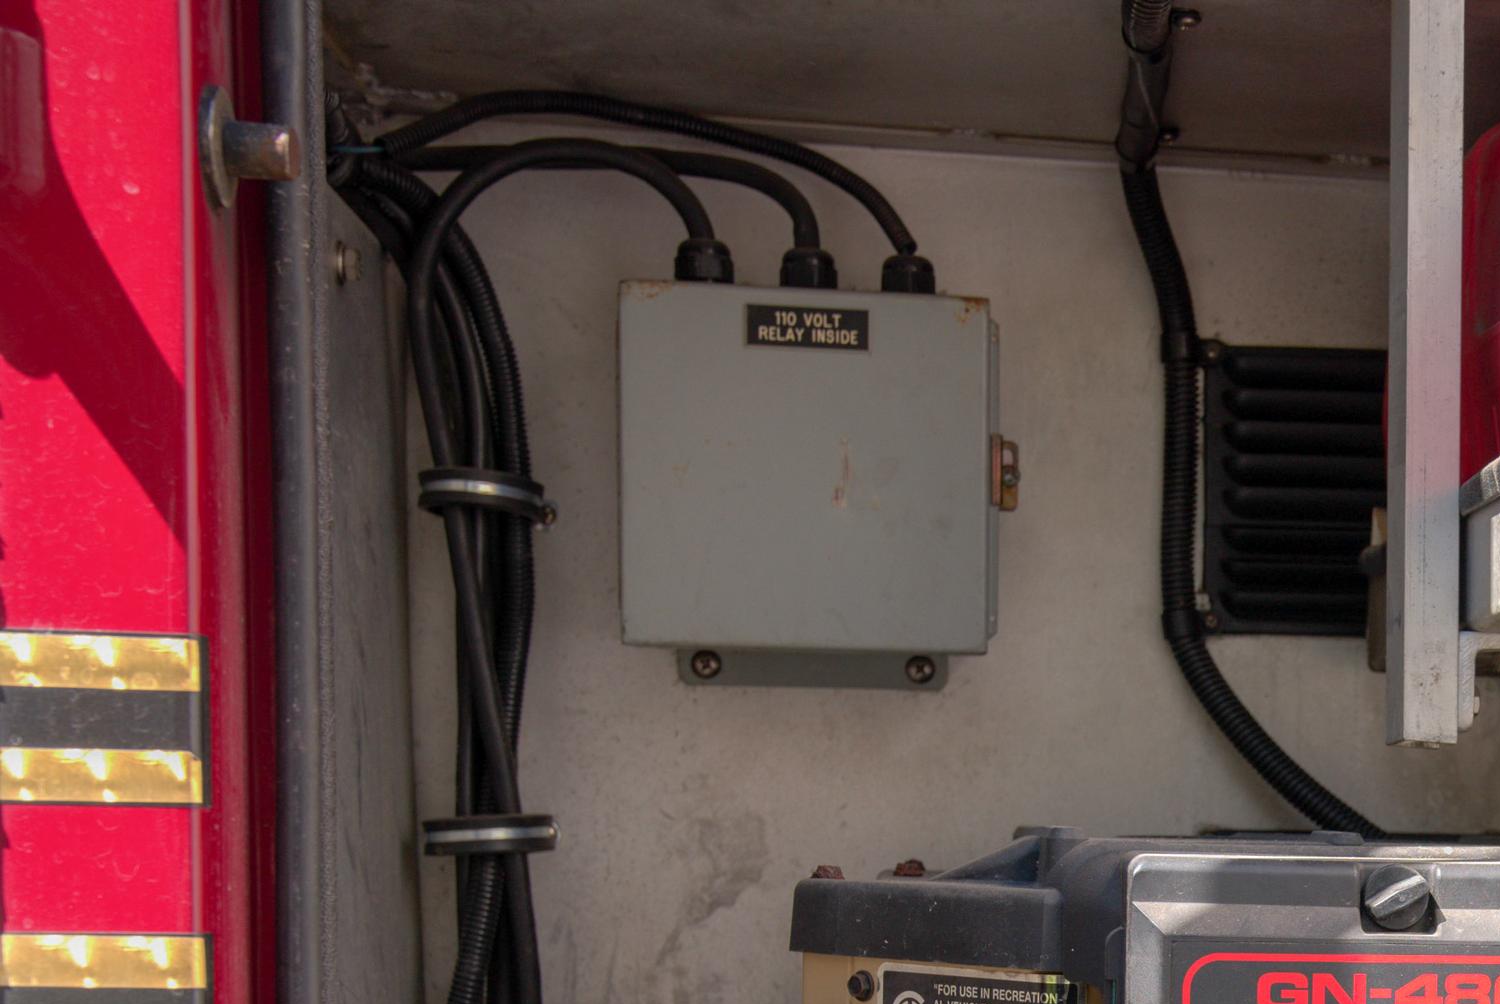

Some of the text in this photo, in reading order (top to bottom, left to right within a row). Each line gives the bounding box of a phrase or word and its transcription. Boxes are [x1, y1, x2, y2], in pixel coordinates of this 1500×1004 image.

[775, 311, 842, 328] 110 VOLT
[758, 325, 858, 345] RELAY INSIDE
[959, 985, 977, 998] USE
[980, 986, 990, 999] IN
